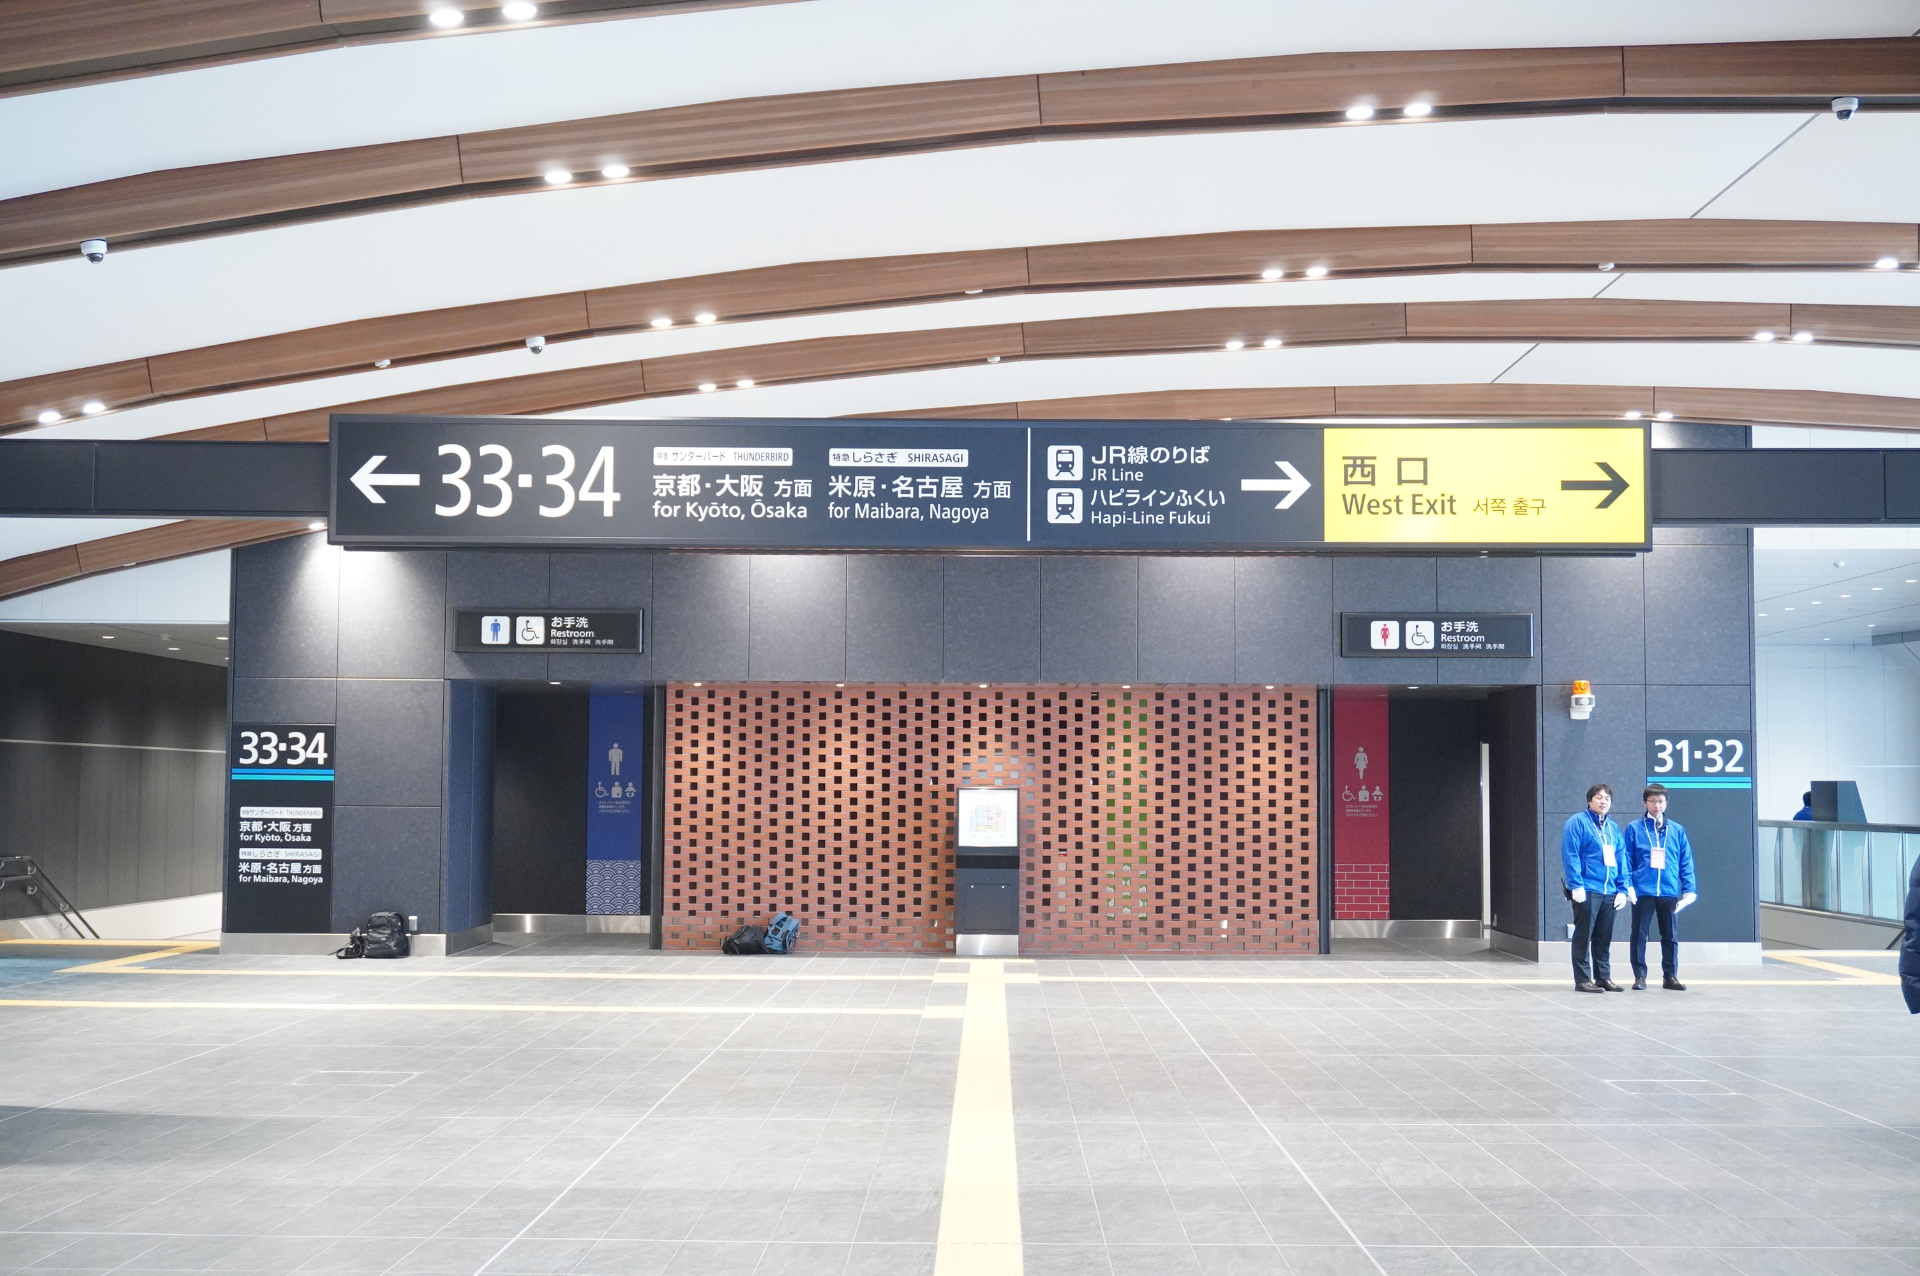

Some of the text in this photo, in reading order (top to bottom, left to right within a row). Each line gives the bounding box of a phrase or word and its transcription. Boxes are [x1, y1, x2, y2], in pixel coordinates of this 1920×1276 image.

[672, 451, 726, 462] サンダーバード
[734, 452, 789, 462] THUNDERBIRD
[908, 453, 963, 463] SHIRASAGI
[1091, 445, 1210, 464] JR線のりば
[1090, 468, 1143, 481] JR Line
[774, 479, 812, 497] 方面
[973, 480, 1011, 499] 方面
[1091, 488, 1225, 507] ハピラインふくい
[1342, 493, 1457, 515] West Exit
[1473, 498, 1546, 516] 서쪽 출구
[652, 499, 807, 522] for Kyōto, Ōsaka
[828, 502, 989, 523] for Maibara, Nagoya
[1091, 510, 1210, 527] Hapi-Line Fukui
[551, 616, 588, 628] お手洗
[1441, 621, 1479, 632] お手洗
[551, 629, 594, 637] Restroom
[1441, 634, 1485, 642] Restroom
[293, 823, 312, 833] 方面
[240, 833, 253, 841] for
[285, 851, 320, 859] SHIRASAGI
[303, 864, 322, 874] 方面
[239, 874, 323, 885] for Maibara, Nagoya
